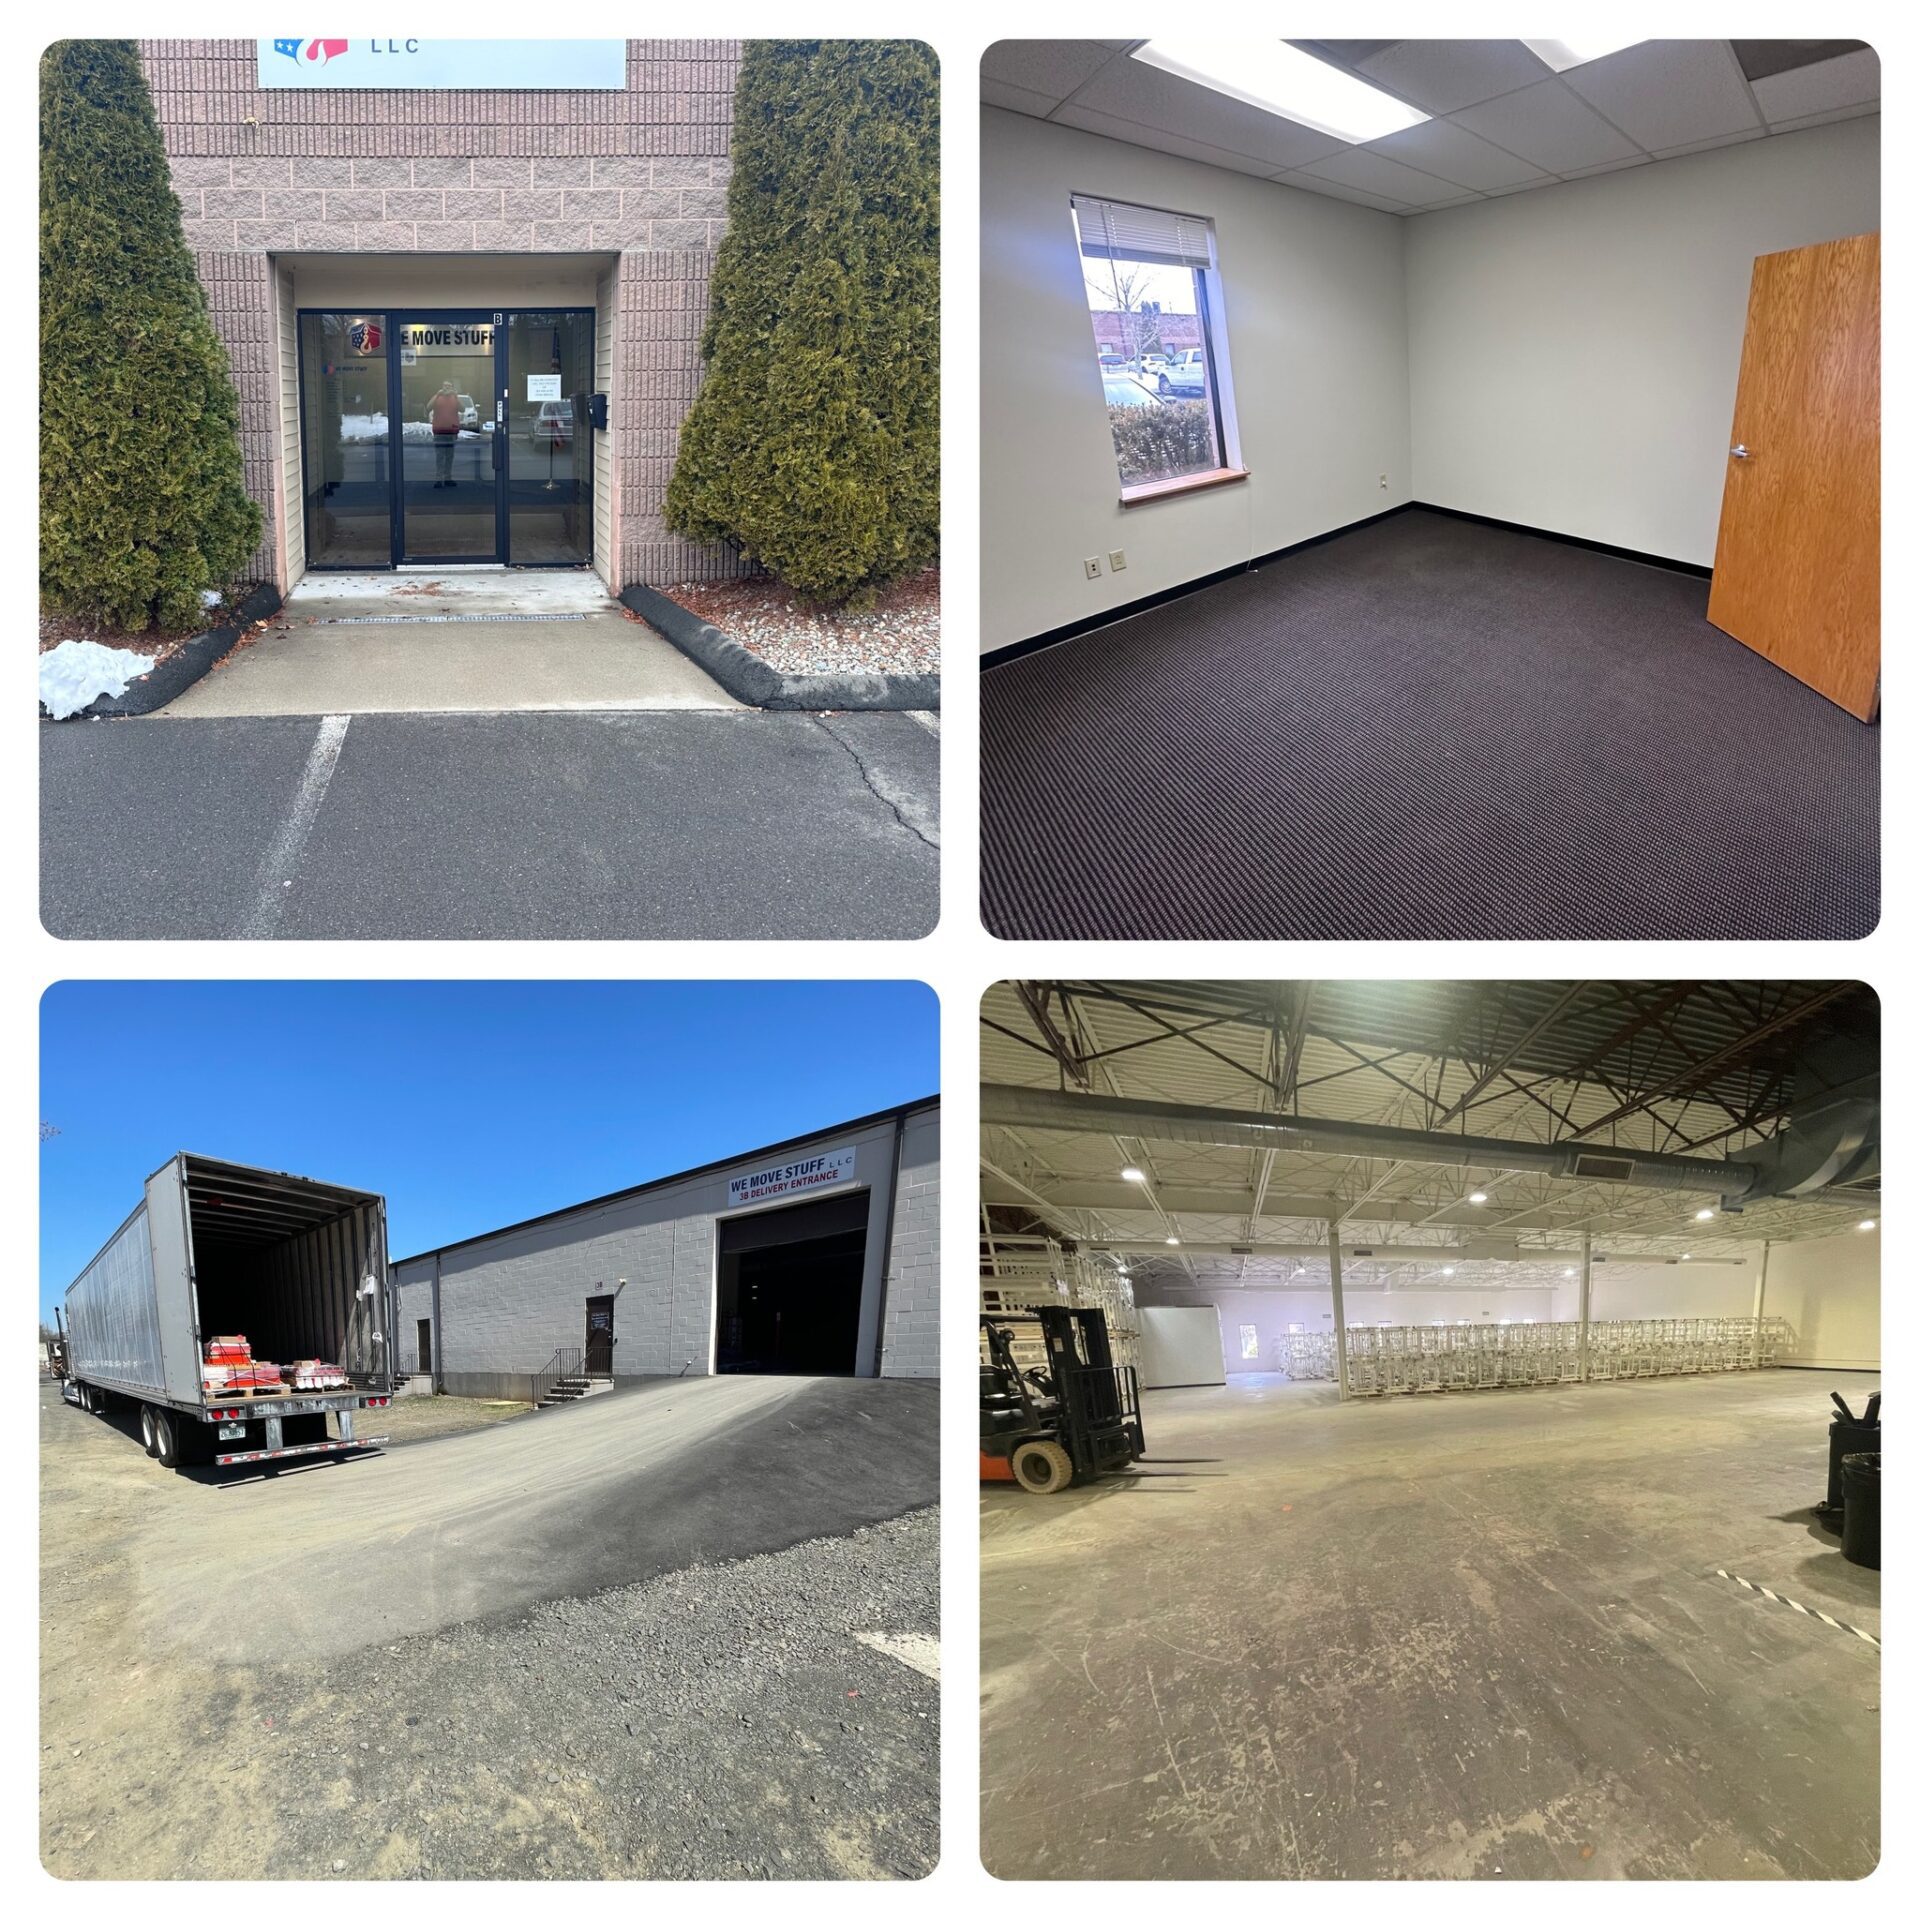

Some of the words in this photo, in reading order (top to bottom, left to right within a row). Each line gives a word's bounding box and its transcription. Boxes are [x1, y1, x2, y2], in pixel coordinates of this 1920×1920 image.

[371, 39, 419, 53] LLC
[412, 330, 451, 346] MOVE
[731, 1178, 748, 1192] WE
[750, 1169, 783, 1188] MOVE
[785, 1157, 826, 1179] STUFF
[739, 1191, 749, 1200] 3B
[751, 1181, 789, 1198] DELIVERY
[791, 1169, 839, 1188] ENTRANCE
